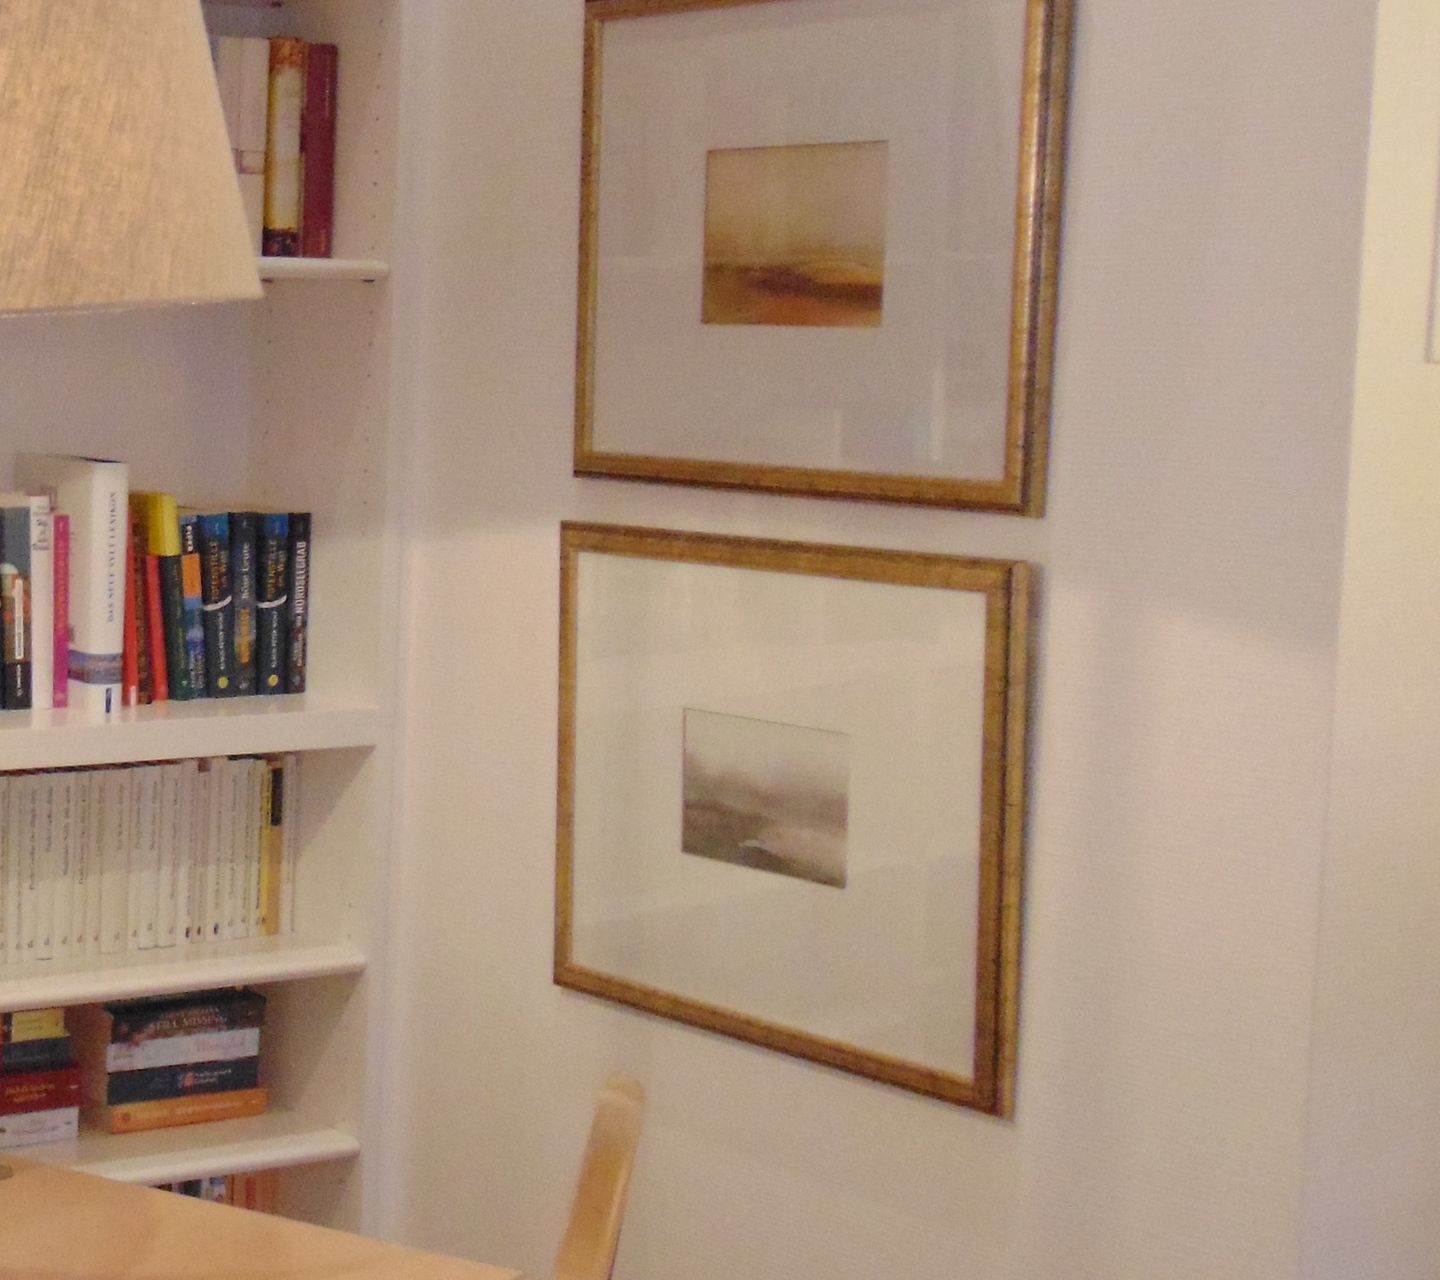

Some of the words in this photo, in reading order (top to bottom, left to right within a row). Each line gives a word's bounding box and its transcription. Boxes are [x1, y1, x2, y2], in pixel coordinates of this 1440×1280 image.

[109, 492, 118, 539] LEXIKON
[109, 540, 117, 567] SYLT
[210, 541, 219, 600] TOTENSTILLE
[267, 540, 277, 599] TOTENSTILLE
[108, 568, 116, 599] NEUE
[295, 541, 307, 614] NORDSEEGRAB
[108, 602, 116, 622] DAS
